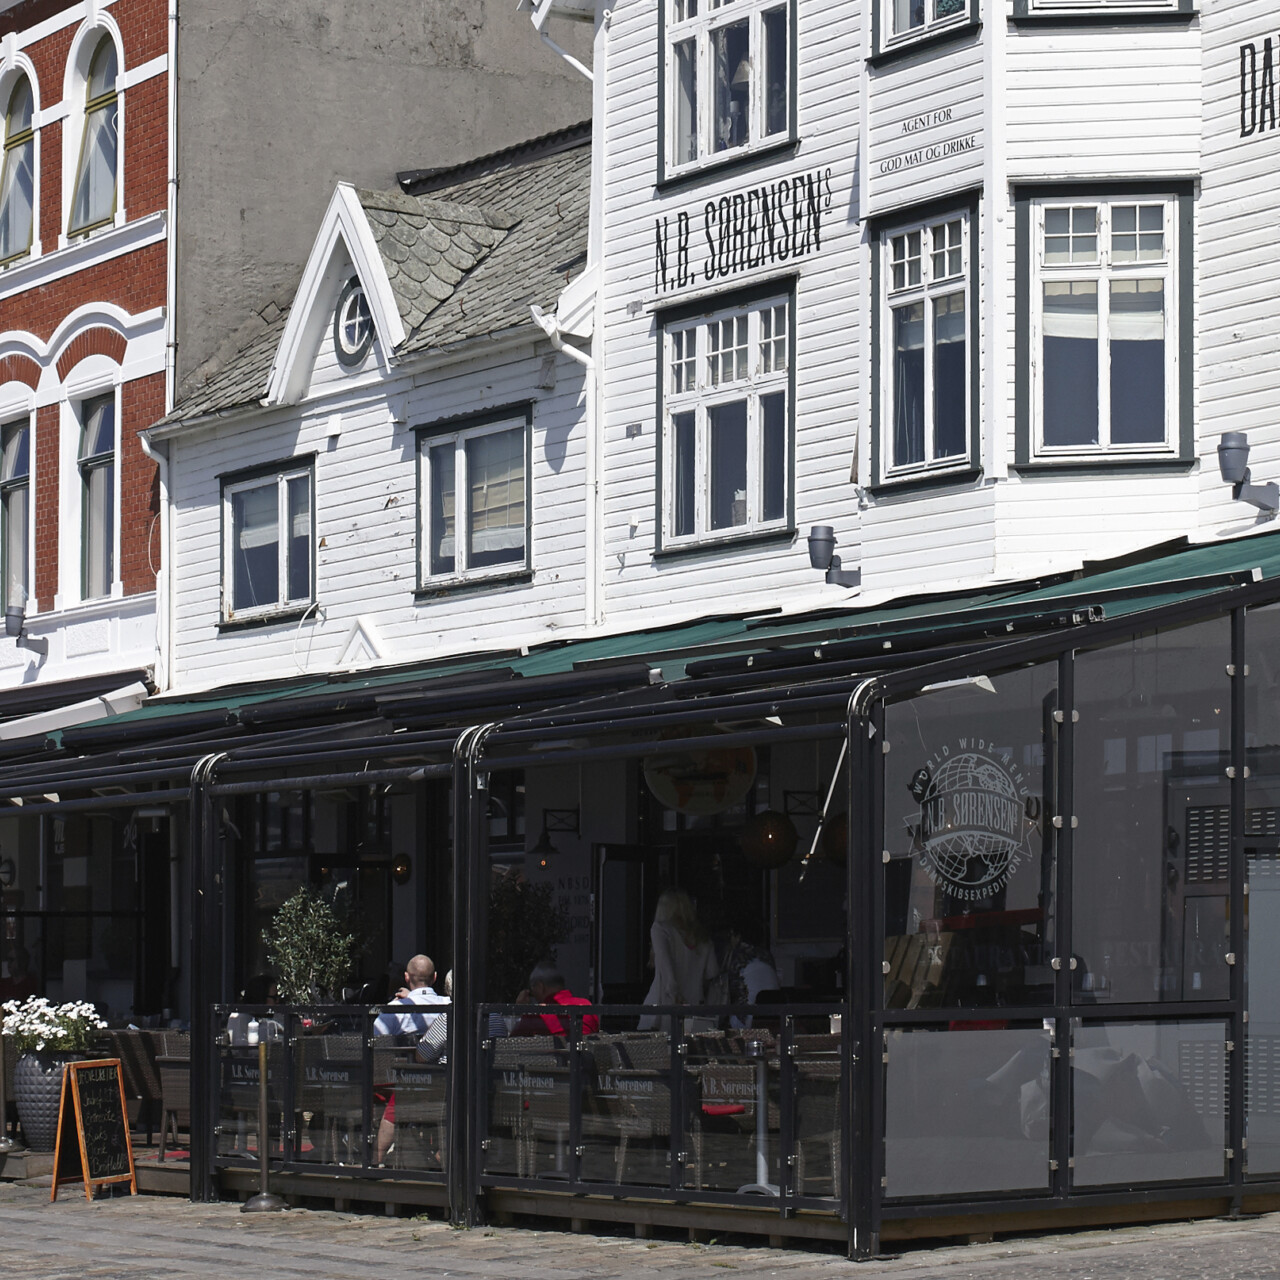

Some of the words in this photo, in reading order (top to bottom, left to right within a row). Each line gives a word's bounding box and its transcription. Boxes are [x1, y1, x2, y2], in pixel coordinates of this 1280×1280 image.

[901, 114, 931, 134] AGENT
[933, 108, 953, 124] FOR
[880, 156, 902, 173] GOD
[904, 149, 923, 167] MAT
[925, 145, 941, 161] OG
[943, 135, 976, 155] DRIKKE
[654, 210, 695, 294] N.B.
[913, 745, 950, 794] WORLD
[959, 737, 995, 753] WIDE
[1000, 752, 1029, 796] MENU
[920, 855, 1022, 900] DAMPSKIBSEXPEDITION
